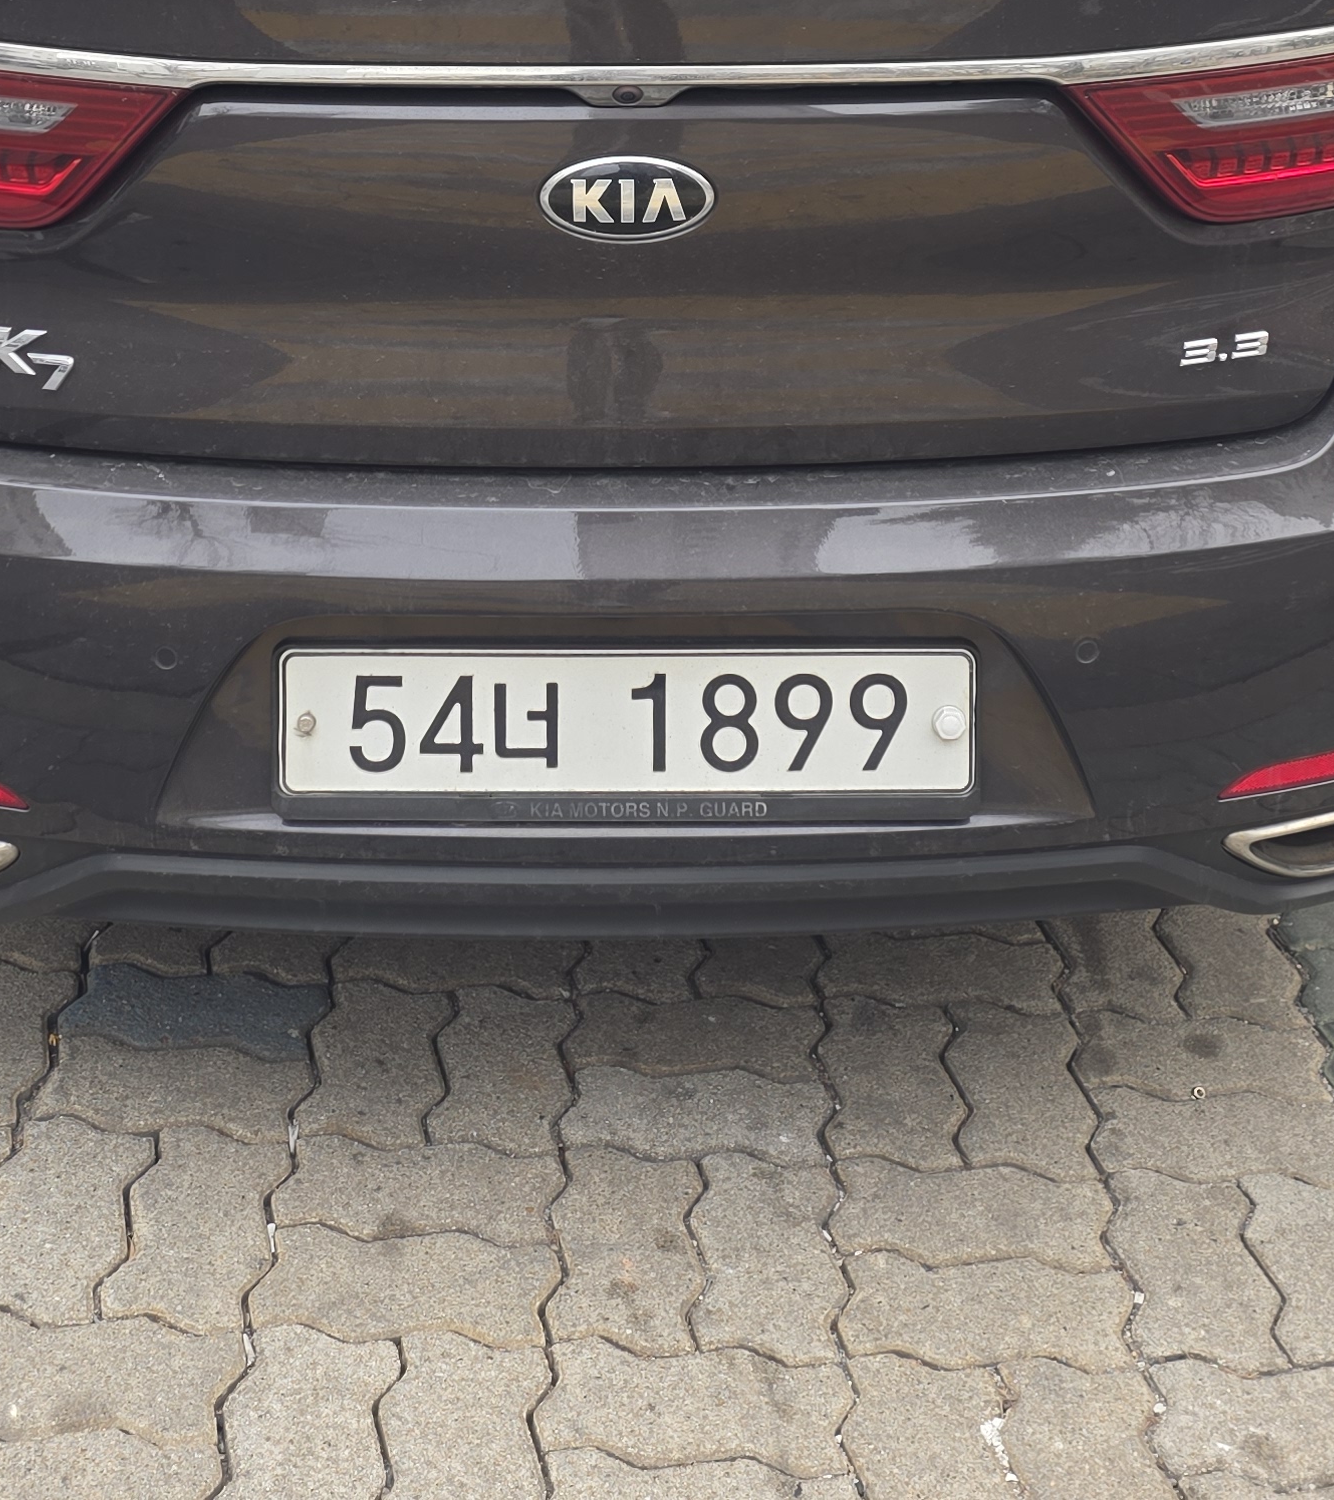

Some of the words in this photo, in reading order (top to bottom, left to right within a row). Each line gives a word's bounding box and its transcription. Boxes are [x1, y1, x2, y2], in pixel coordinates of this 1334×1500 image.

[570, 178, 687, 224] KIA
[1179, 331, 1270, 367] 3.3
[349, 674, 559, 773] 54너
[630, 672, 909, 772] 1899
[530, 802, 564, 818] KIA
[569, 802, 651, 818] MOTORS
[656, 802, 694, 818] N.P.
[699, 801, 768, 818] GUARD
